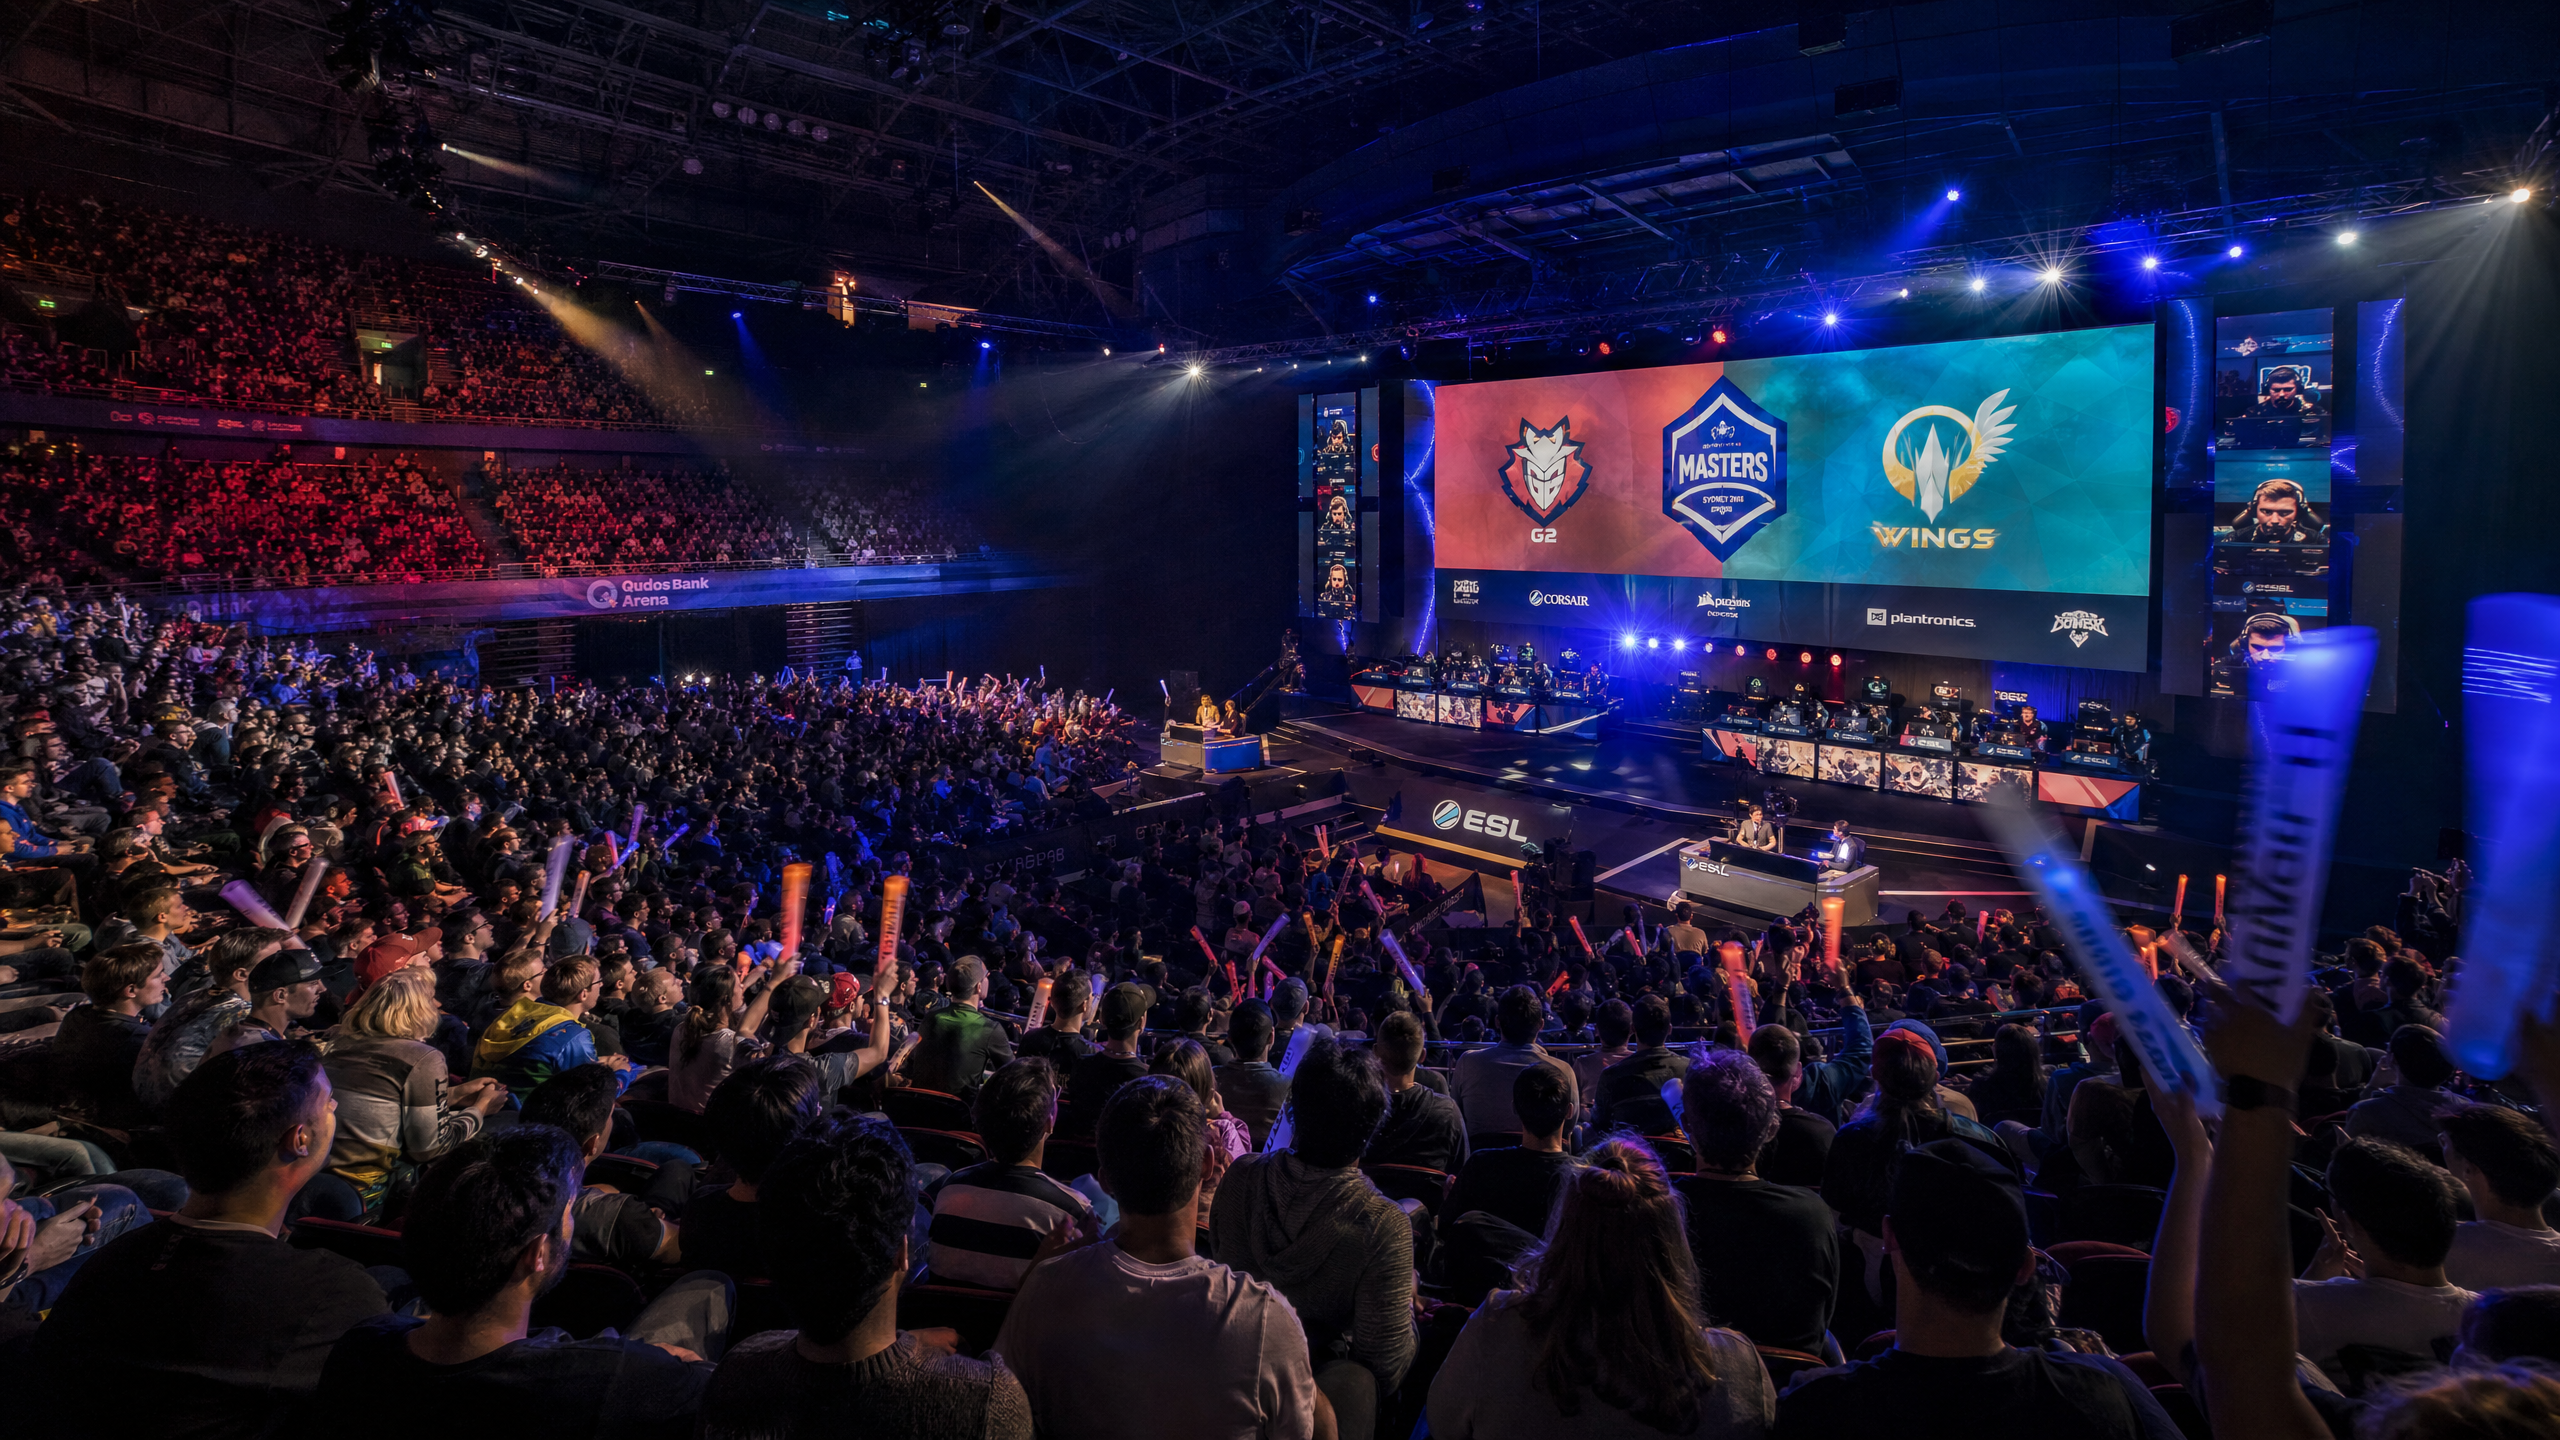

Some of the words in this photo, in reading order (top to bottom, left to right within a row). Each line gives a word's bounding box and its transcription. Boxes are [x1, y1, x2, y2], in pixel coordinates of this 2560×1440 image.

[1679, 452, 1768, 485] MASTERS
[1530, 527, 1557, 543] G2
[1871, 525, 1998, 549] WINGS
[621, 578, 671, 593] Qudos
[672, 577, 710, 590] Bank
[622, 595, 669, 607] Arena
[1544, 593, 1590, 607] CORSAIR
[1463, 809, 1528, 843] ESL
